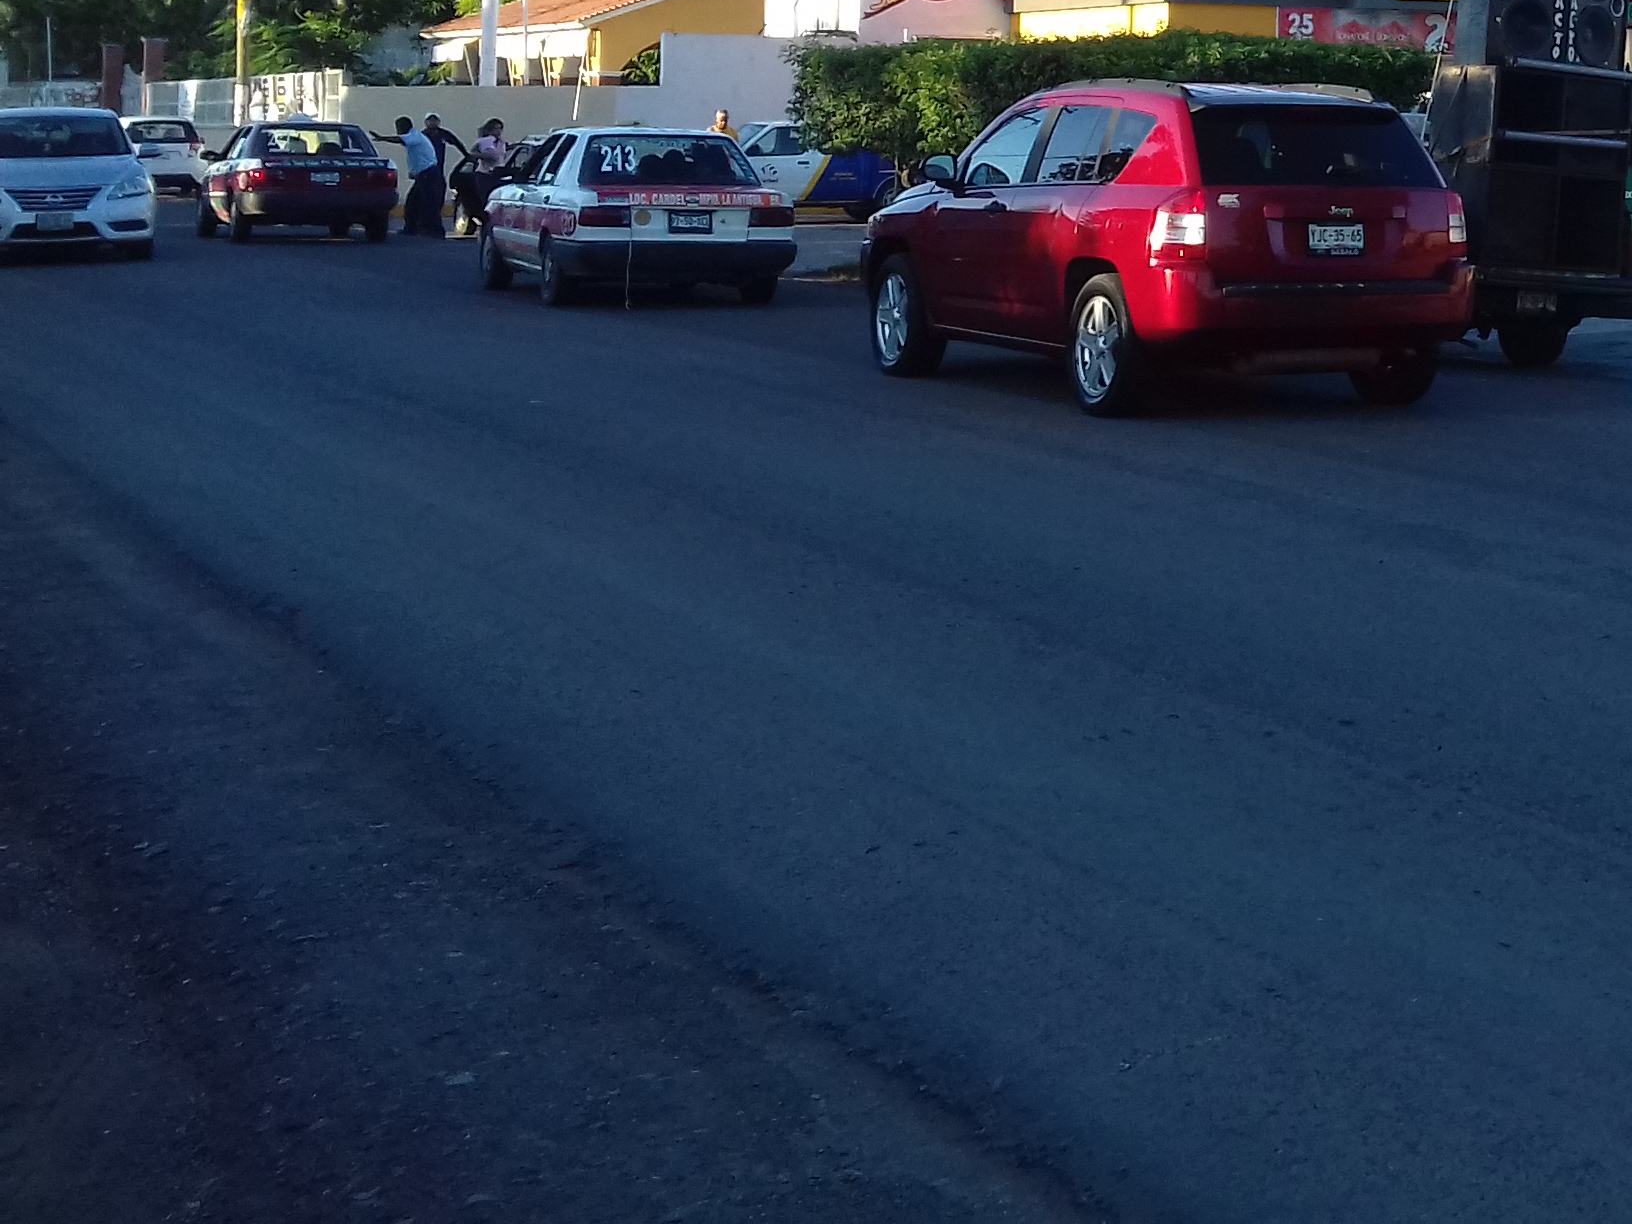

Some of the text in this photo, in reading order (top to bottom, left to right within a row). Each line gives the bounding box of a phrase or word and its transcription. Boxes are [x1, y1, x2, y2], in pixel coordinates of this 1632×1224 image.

[1288, 12, 1315, 35] 25
[600, 145, 636, 173] 213
[652, 194, 687, 205] CARDEL
[722, 194, 731, 205] LA
[1328, 205, 1353, 217] Jeep
[1310, 229, 1363, 243] YJC-35-65
